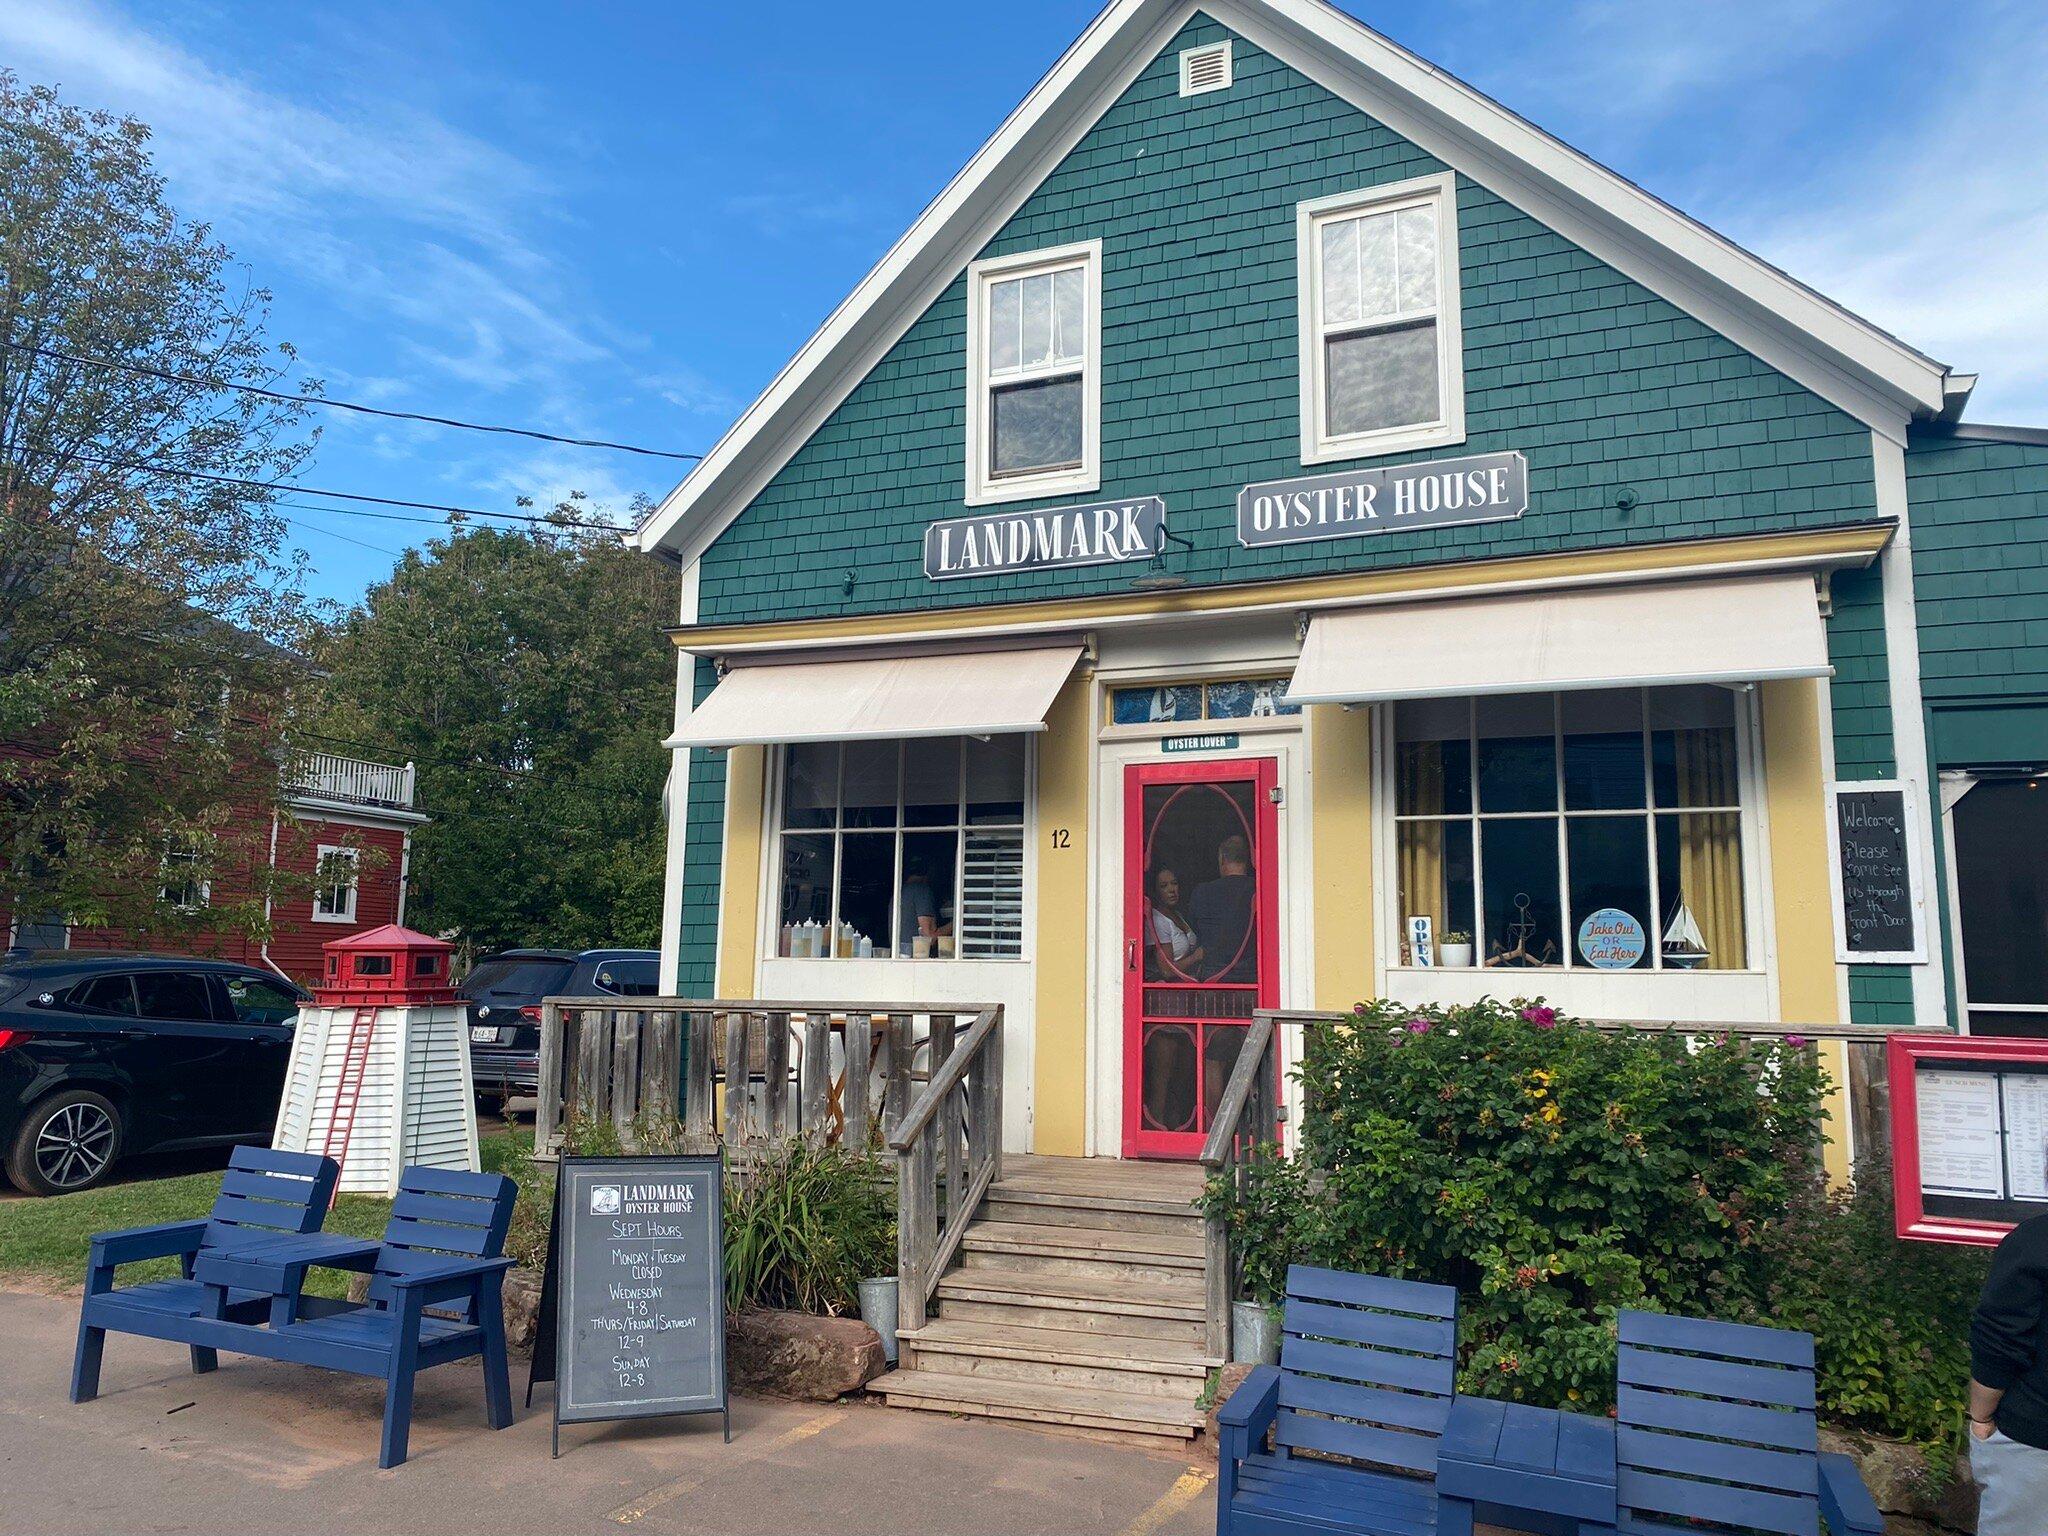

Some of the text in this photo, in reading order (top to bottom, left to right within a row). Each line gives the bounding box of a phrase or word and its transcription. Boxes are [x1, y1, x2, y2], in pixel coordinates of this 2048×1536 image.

[1253, 467, 1509, 532] OYSTER HOUSE
[938, 505, 1148, 572] LANDMARK
[1168, 737, 1198, 750] OYSTER
[1200, 736, 1226, 748] LOVER
[1841, 802, 1896, 827] Welcome
[1052, 829, 1071, 849] 12
[1846, 840, 1889, 859] Please
[1850, 909, 1878, 929] Front
[1586, 921, 1634, 937] Take Out
[1414, 919, 1429, 966] OPEN
[1602, 936, 1620, 945] OR
[1588, 944, 1638, 961] Eat Here
[623, 1184, 695, 1202] LANDMARK
[625, 1201, 693, 1214] OYSTER HOUSE
[611, 1219, 682, 1238] SEPT HOURS
[612, 1248, 649, 1266] MONDAY
[632, 1265, 663, 1280] CLOSED
[608, 1282, 663, 1300] WEDNESDAY
[627, 1300, 648, 1316] 4-8
[618, 1335, 644, 1350] 12-9
[612, 1355, 651, 1372] SUNDAY
[619, 1373, 645, 1388] 12-8
